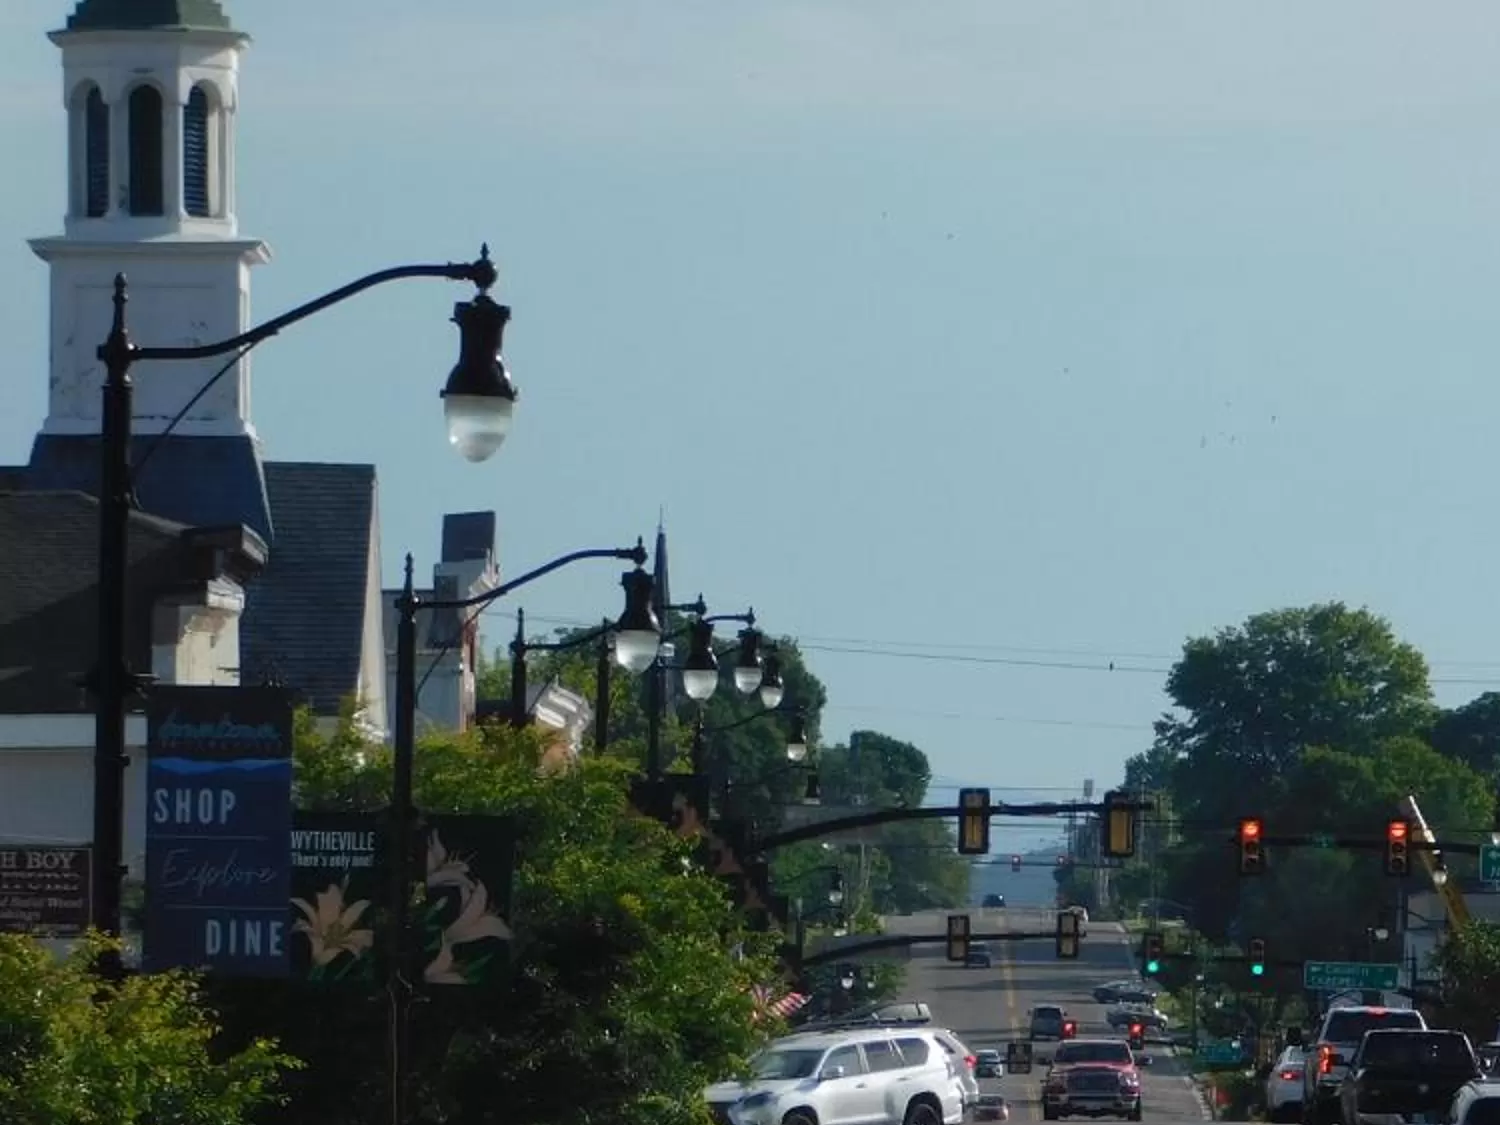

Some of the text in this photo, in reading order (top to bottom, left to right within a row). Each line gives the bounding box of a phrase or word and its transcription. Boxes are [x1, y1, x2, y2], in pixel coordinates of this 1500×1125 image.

[153, 788, 237, 824] SHOP
[290, 831, 376, 850] WYTHEVILLE
[26, 851, 80, 869] BOY
[160, 848, 279, 897] Explore
[205, 919, 285, 956] DINE
